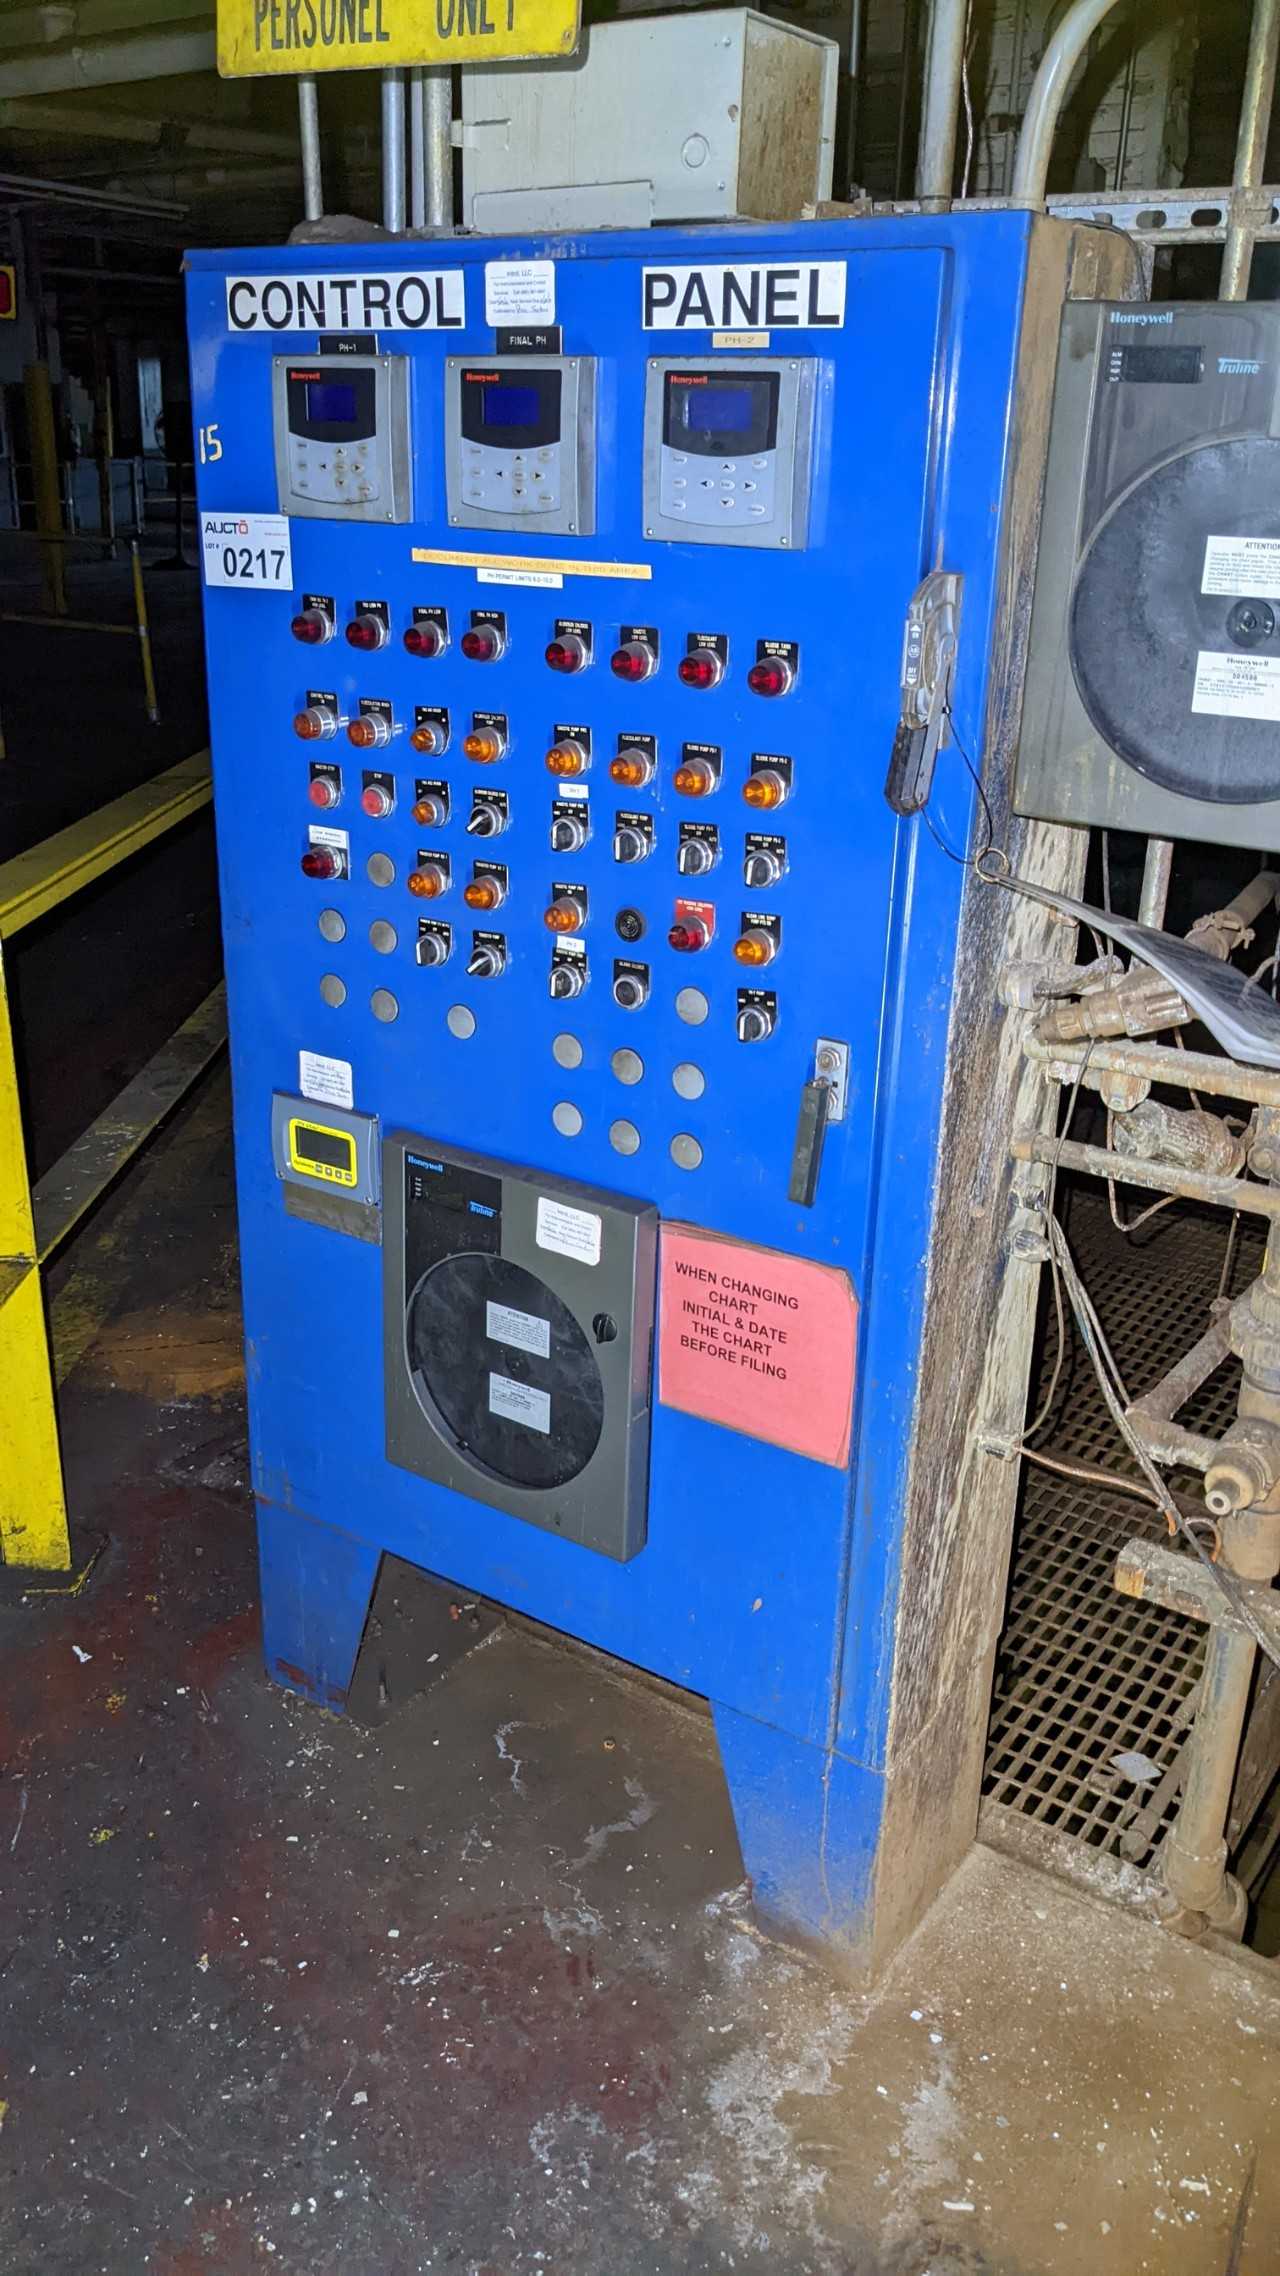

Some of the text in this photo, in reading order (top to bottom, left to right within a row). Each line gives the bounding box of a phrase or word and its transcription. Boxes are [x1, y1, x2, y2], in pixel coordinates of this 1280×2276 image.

[229, 277, 462, 329] CONTROL
[645, 269, 840, 327] PANEL
[1110, 312, 1173, 325] Honeywell
[339, 343, 356, 352] PH-1
[510, 336, 546, 345] FINAL PH
[725, 336, 755, 344] PH-2
[466, 373, 500, 382] Honeywell
[671, 376, 708, 385] Honeywell
[200, 424, 222, 464] 15
[223, 547, 285, 580] 0217
[408, 1155, 443, 1173] Honeywell
[675, 1261, 799, 1310] WHEN CHANGING
[709, 1291, 758, 1315] CHART
[683, 1300, 788, 1344] INITIAL & DATE
[692, 1321, 773, 1356] THE CHART
[681, 1335, 787, 1380] BEFORE FILING
